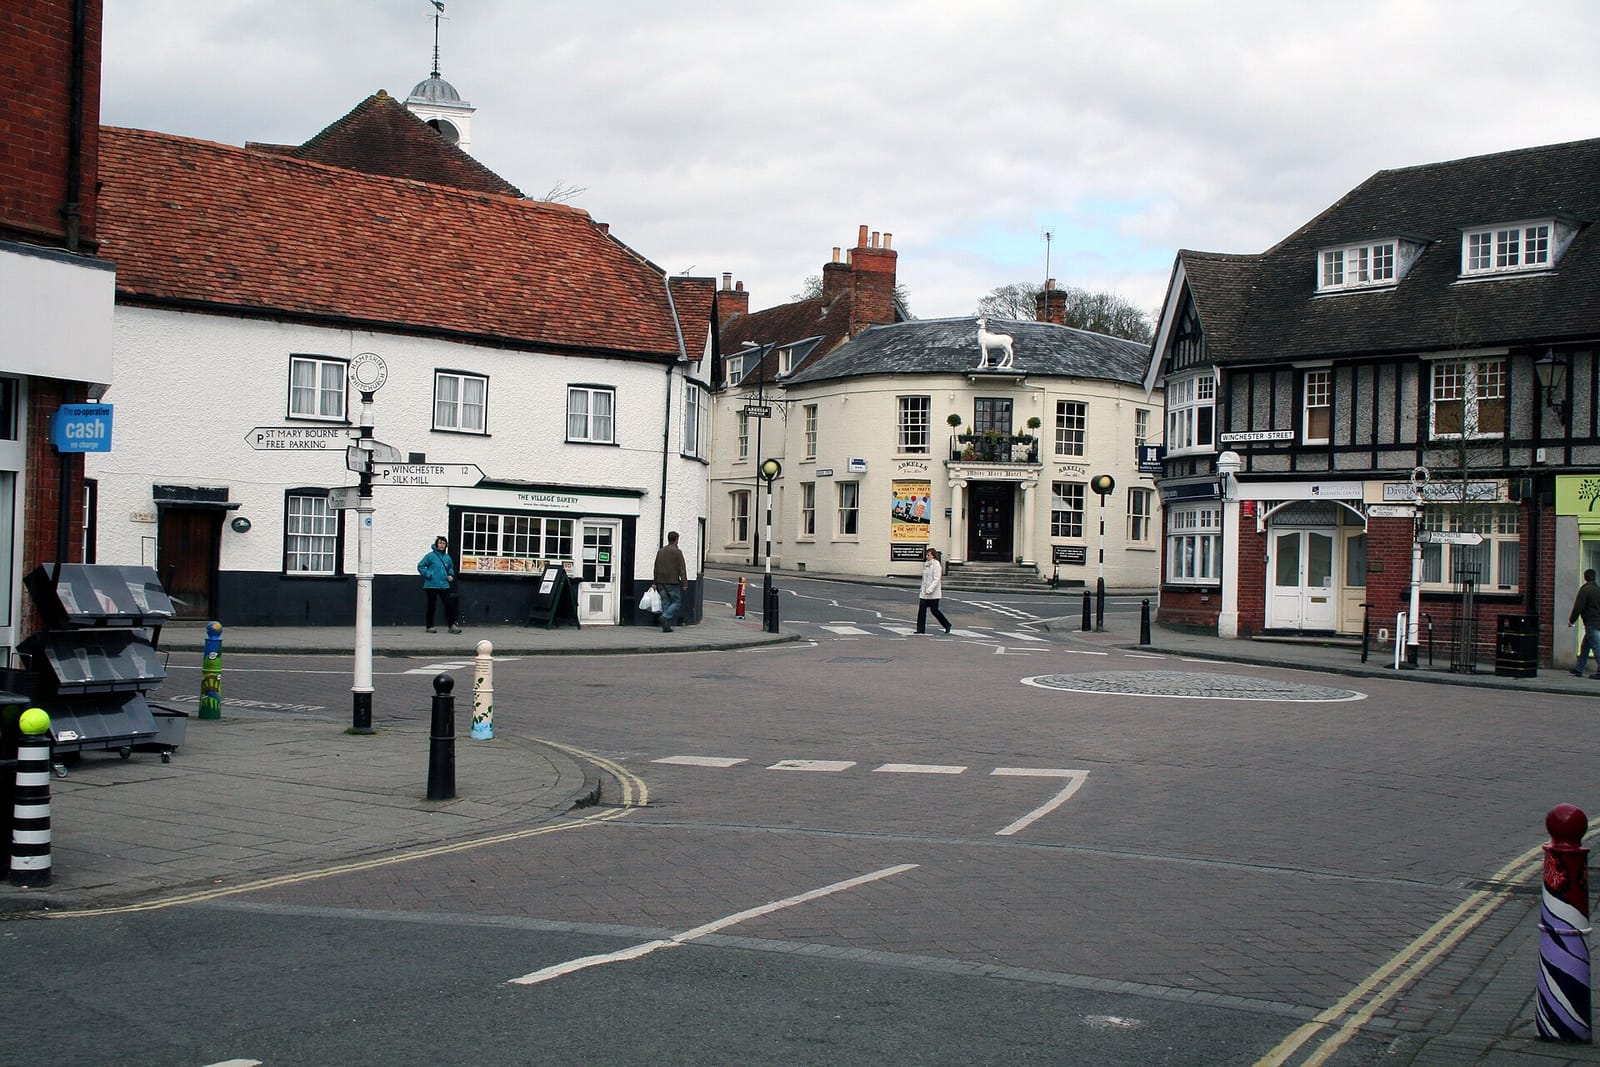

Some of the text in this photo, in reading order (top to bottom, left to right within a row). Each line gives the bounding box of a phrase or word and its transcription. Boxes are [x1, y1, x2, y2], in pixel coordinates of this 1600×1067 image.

[65, 418, 105, 439] cash
[257, 434, 264, 444] P
[265, 430, 350, 438] ST MARY BOURNE 4
[1222, 431, 1293, 441] WINCHESTER STREET
[266, 440, 326, 449] FREE PARKING
[392, 465, 469, 475] WINCHESTER 12
[897, 461, 928, 472] ARKELLS
[1058, 465, 1085, 475] ARKELLS
[383, 469, 390, 479] P
[392, 475, 429, 484] SILK MILL
